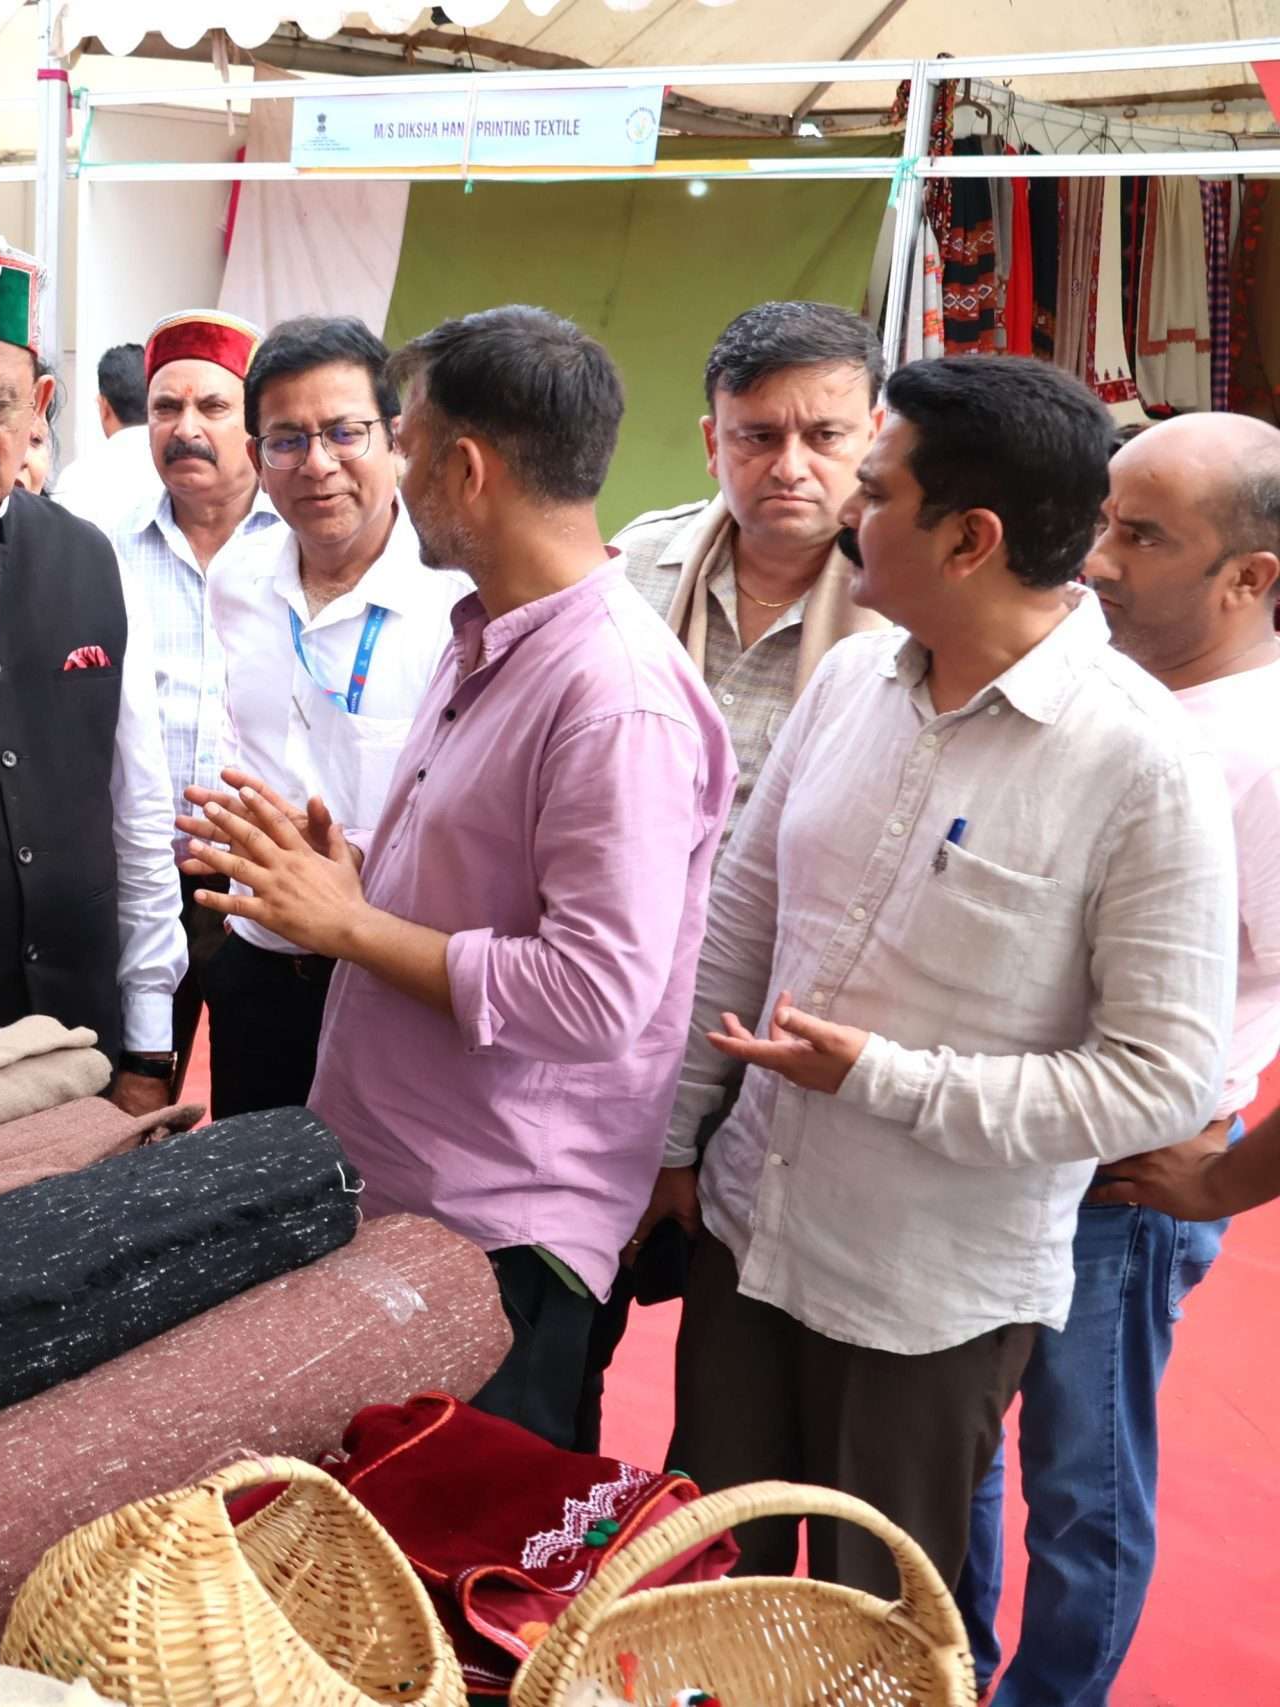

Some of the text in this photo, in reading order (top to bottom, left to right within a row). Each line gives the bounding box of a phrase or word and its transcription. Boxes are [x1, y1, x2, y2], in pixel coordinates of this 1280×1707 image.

[398, 121, 438, 138] DIKSHA
[442, 121, 474, 137] HAN
[476, 119, 531, 137] PRINTING
[535, 118, 581, 136] TEXTILE
